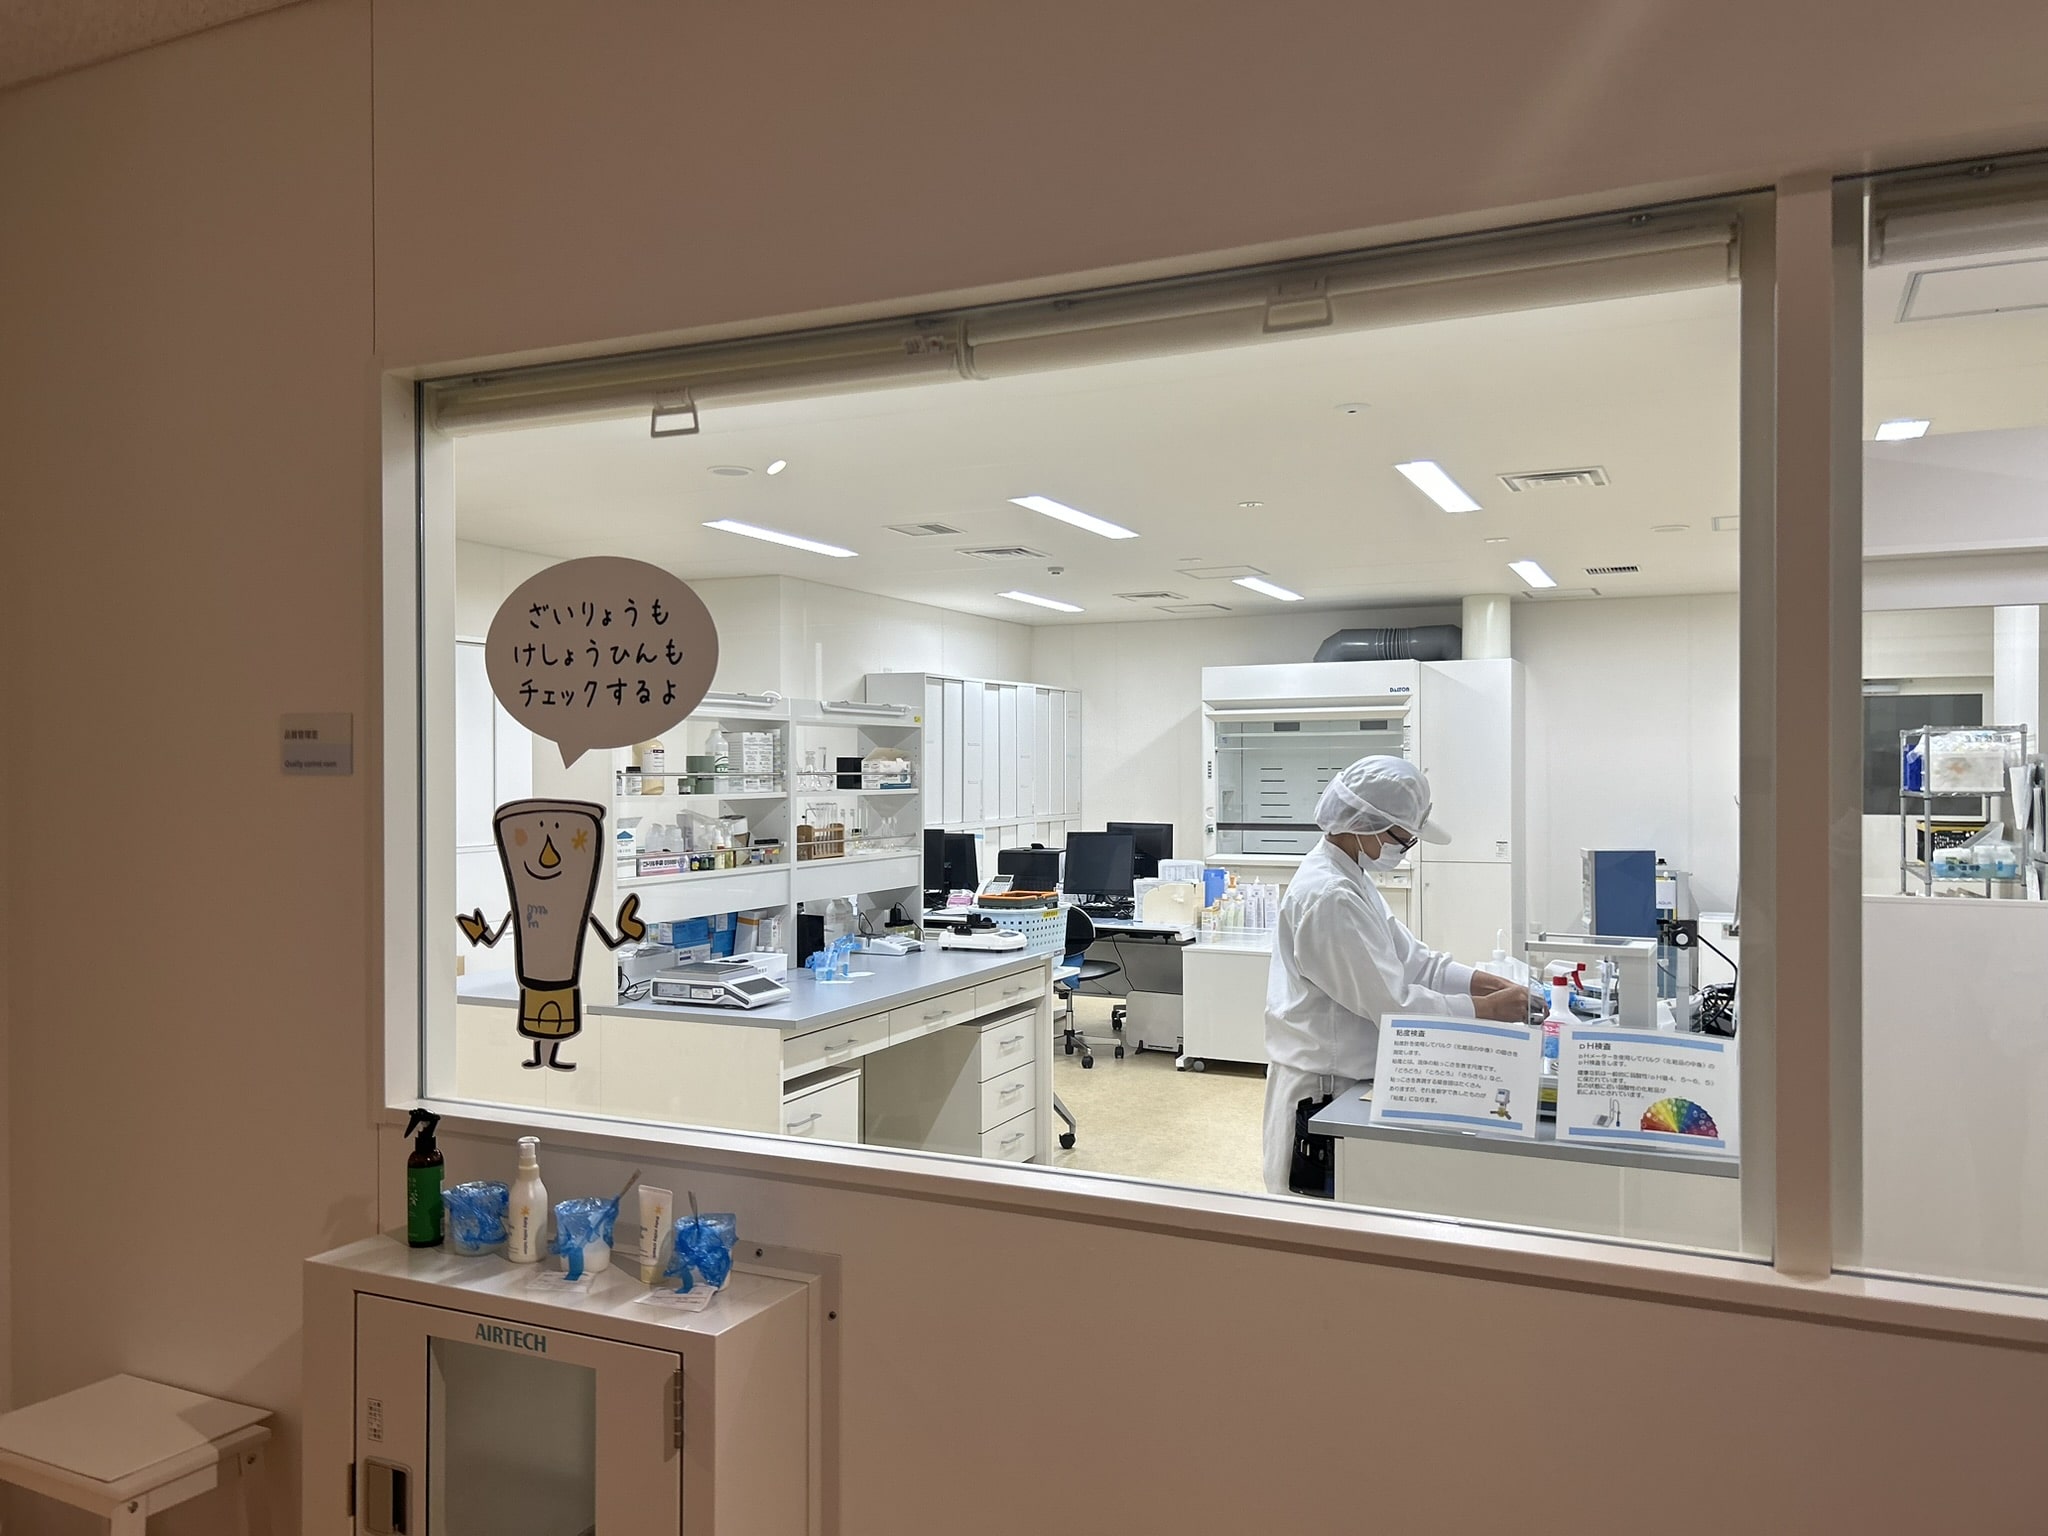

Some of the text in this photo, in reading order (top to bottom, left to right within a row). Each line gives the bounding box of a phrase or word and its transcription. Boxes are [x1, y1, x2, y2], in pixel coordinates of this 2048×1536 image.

[528, 598, 670, 629] ざいりょうも
[513, 638, 684, 667] けしょうひんも
[518, 678, 677, 708] チェックするよ
[1395, 1029, 1426, 1038] 粘度検査
[475, 1322, 547, 1353] AIRTECH
